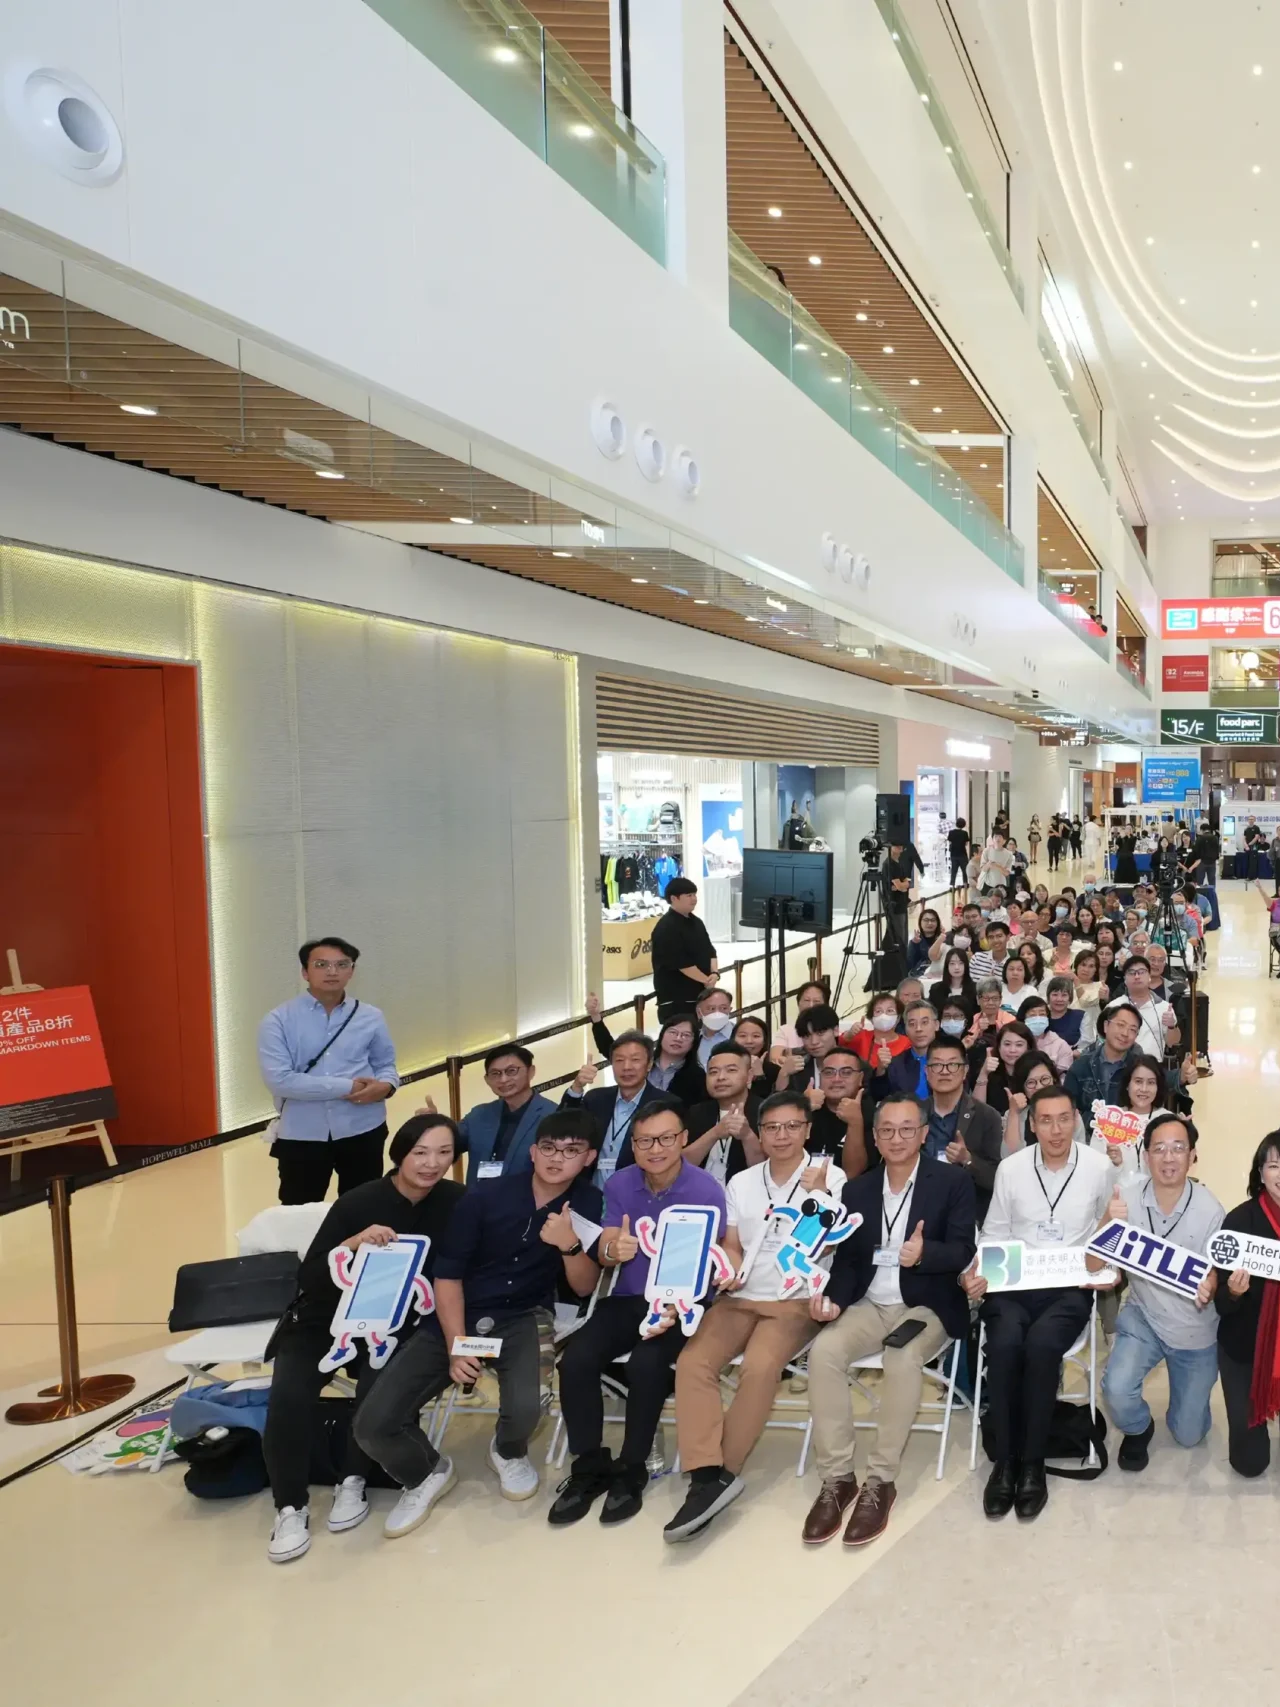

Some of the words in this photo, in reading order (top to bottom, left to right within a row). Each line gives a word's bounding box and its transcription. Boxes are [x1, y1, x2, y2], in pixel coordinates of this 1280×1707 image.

[1172, 719, 1205, 736] 15/F
[1219, 717, 1241, 727] food
[16, 1035, 37, 1045] OFF
[61, 1034, 91, 1046] ITEMS
[141, 1142, 190, 1167] HOPEWELL
[190, 1138, 214, 1152] MALL
[1023, 1269, 1045, 1277] Hong
[1046, 1267, 1067, 1275] Kong
[1241, 1257, 1274, 1276] Hong
